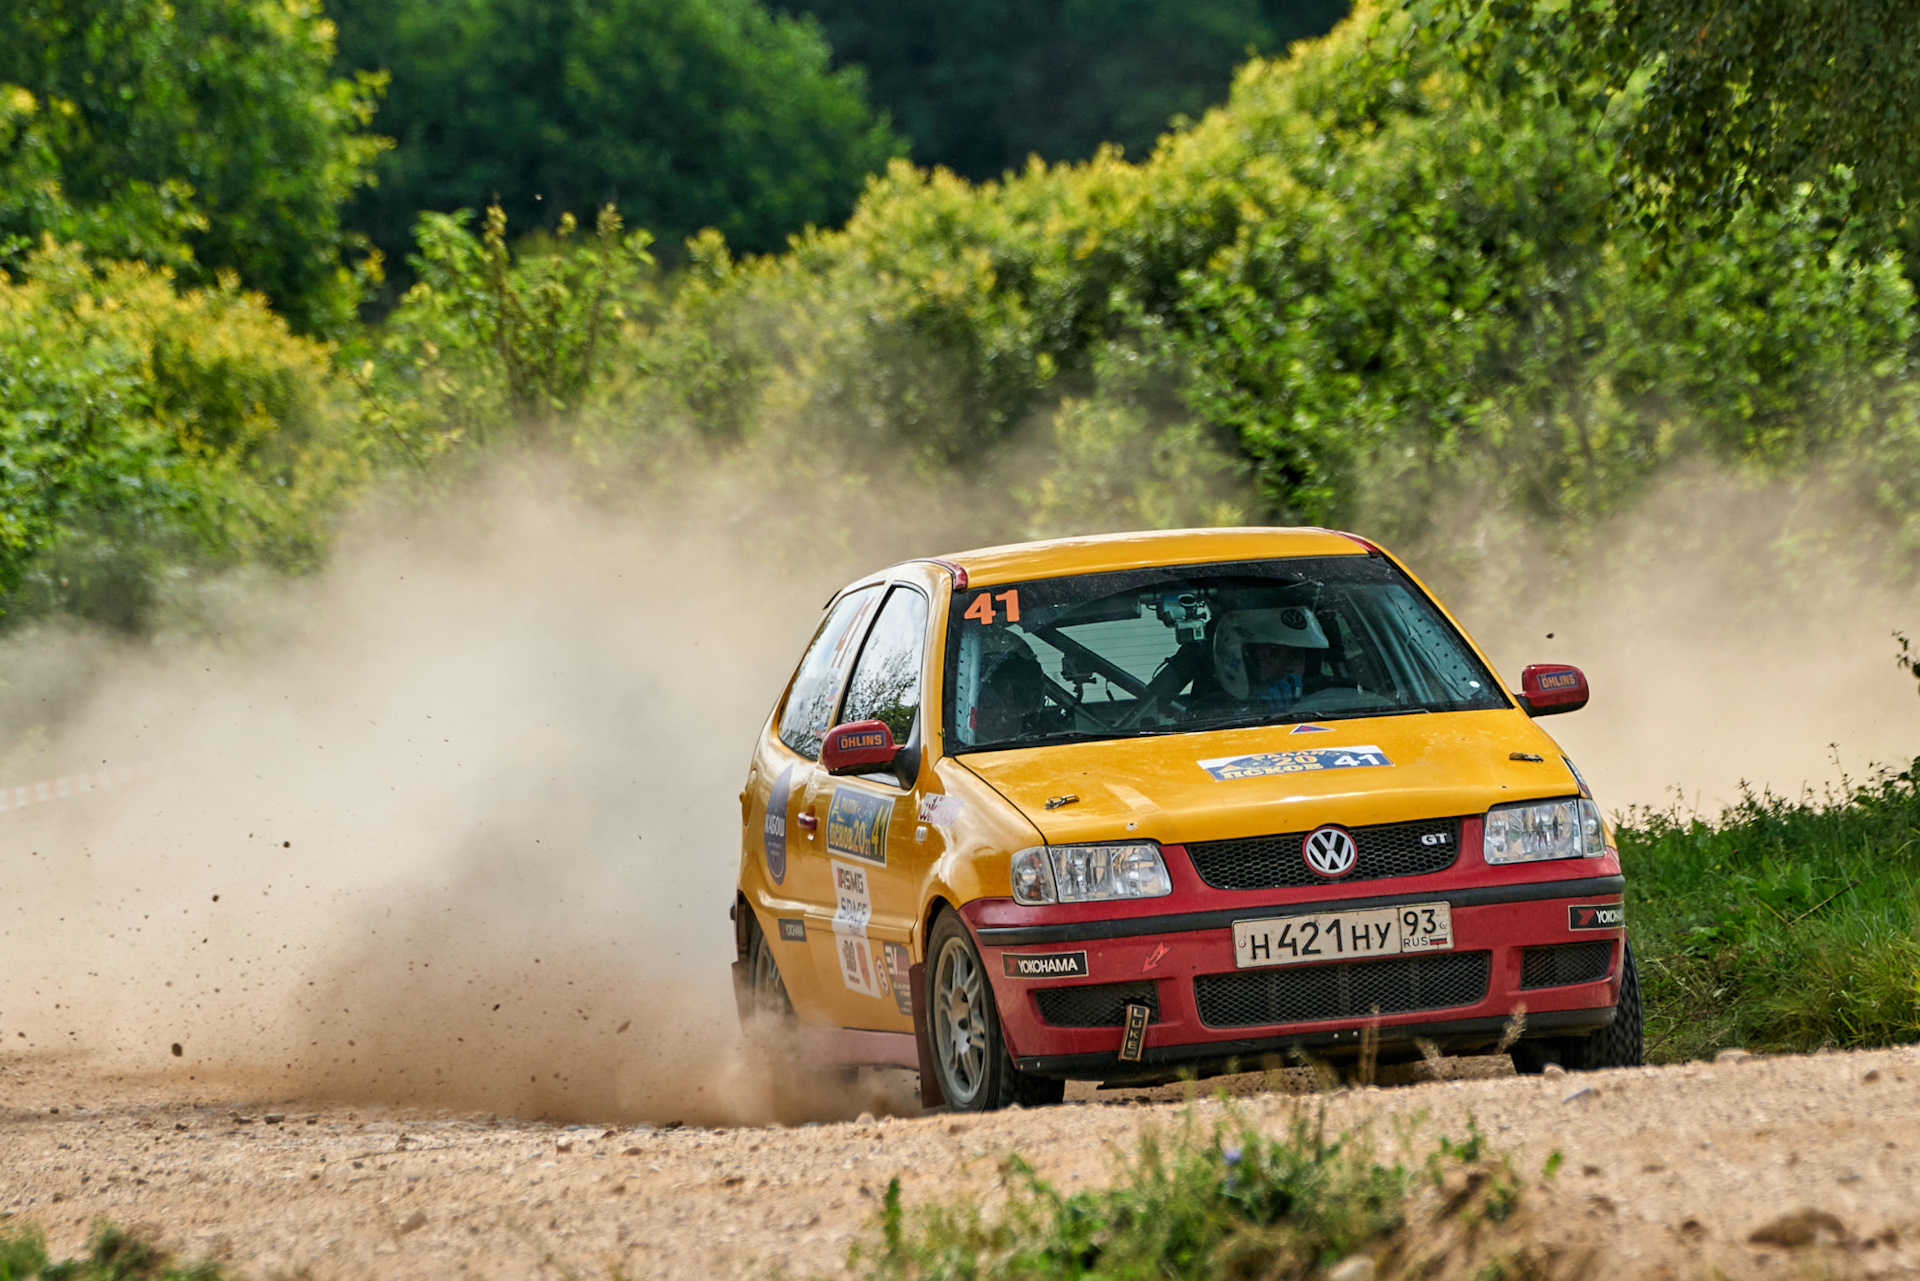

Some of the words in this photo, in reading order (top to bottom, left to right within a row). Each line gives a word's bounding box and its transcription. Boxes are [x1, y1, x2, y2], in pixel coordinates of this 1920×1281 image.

[963, 589, 1020, 625] 41
[1541, 674, 1576, 688] ÖHLINS
[840, 733, 882, 749] ÖHLINS
[1333, 753, 1381, 767] 41
[1222, 762, 1324, 779] ПСКОВ
[870, 805, 890, 857] 41
[1421, 832, 1448, 846] GT
[1403, 909, 1437, 936] 93
[1403, 938, 1429, 948] RUS
[1018, 957, 1078, 974] YOKOHAMA
[1126, 1008, 1144, 1050] LUKE
